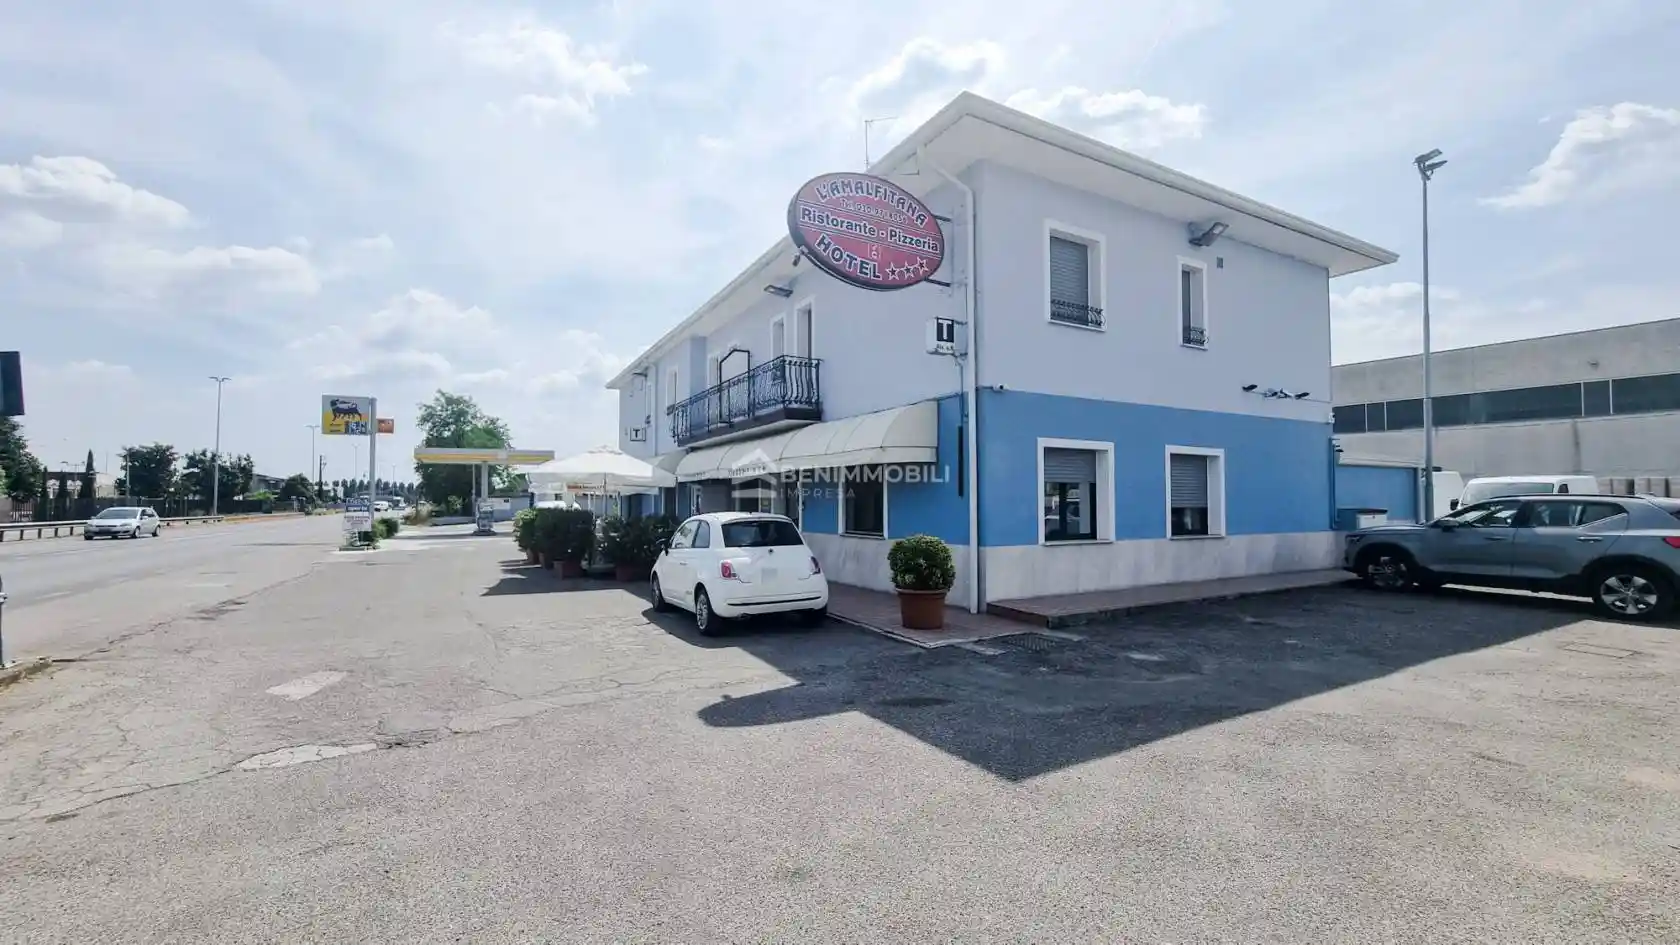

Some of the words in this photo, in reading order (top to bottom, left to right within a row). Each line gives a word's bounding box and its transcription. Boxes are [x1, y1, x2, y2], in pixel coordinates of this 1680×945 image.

[815, 179, 928, 228] L'AMALFITANA
[801, 207, 877, 237] Ristorante
[887, 227, 940, 253] Pizzeria
[815, 233, 882, 280] HOTEL
[938, 319, 952, 340] T
[632, 427, 641, 438] T
